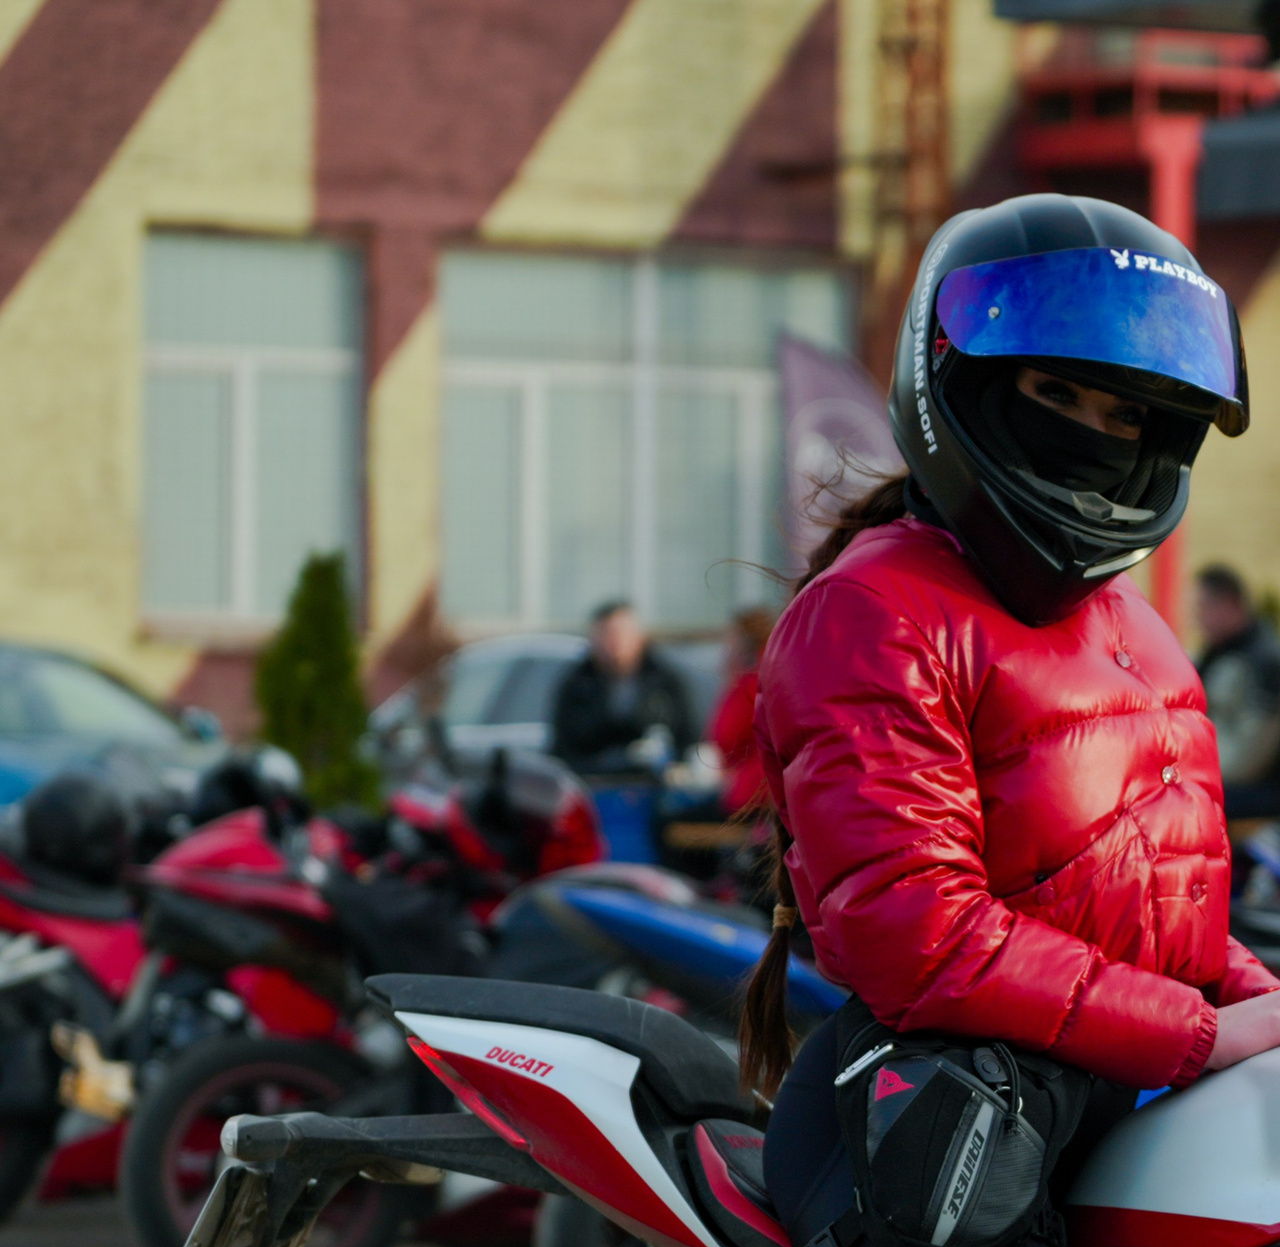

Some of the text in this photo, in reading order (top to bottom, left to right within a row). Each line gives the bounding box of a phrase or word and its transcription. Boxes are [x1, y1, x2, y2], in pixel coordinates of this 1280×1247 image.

[1134, 254, 1218, 298] PLAYBOY
[484, 1046, 555, 1077] DUCATI
[946, 1128, 986, 1220] DAINESE
